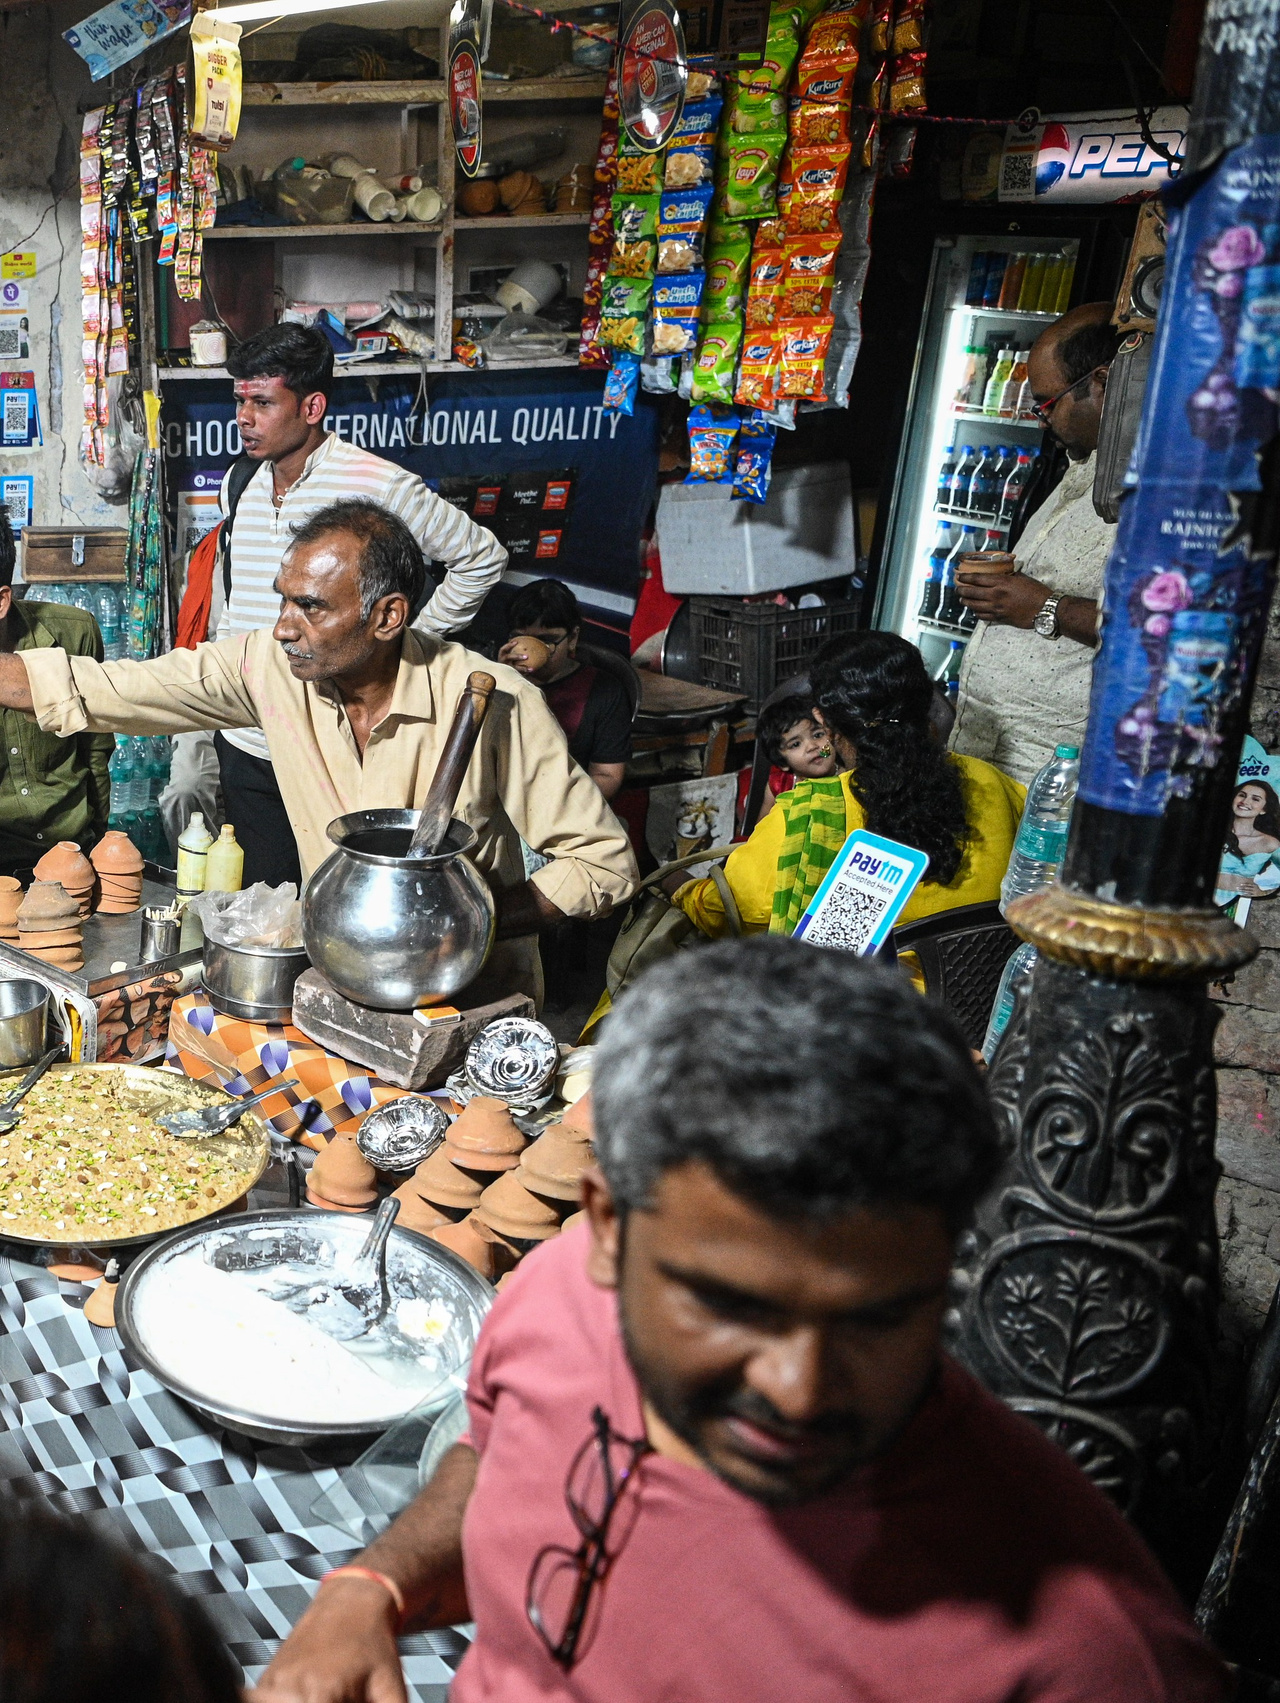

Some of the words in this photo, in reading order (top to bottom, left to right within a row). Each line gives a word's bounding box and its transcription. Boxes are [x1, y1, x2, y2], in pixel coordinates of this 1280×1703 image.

[84, 22, 110, 41] thin
[635, 23, 645, 35] AN
[98, 22, 133, 51] wafer
[207, 51, 228, 66] BIGGER
[1069, 131, 1187, 179] PEP
[670, 284, 697, 295] Uncle
[667, 293, 698, 304] Chipps
[166, 419, 242, 459] CHOO
[511, 406, 622, 447] QUALITY
[206, 477, 224, 486] Phon
[513, 489, 539, 499] Meethe
[1238, 763, 1270, 777] eeze
[843, 868, 876, 888] Accepted
[876, 883, 894, 896] Here
